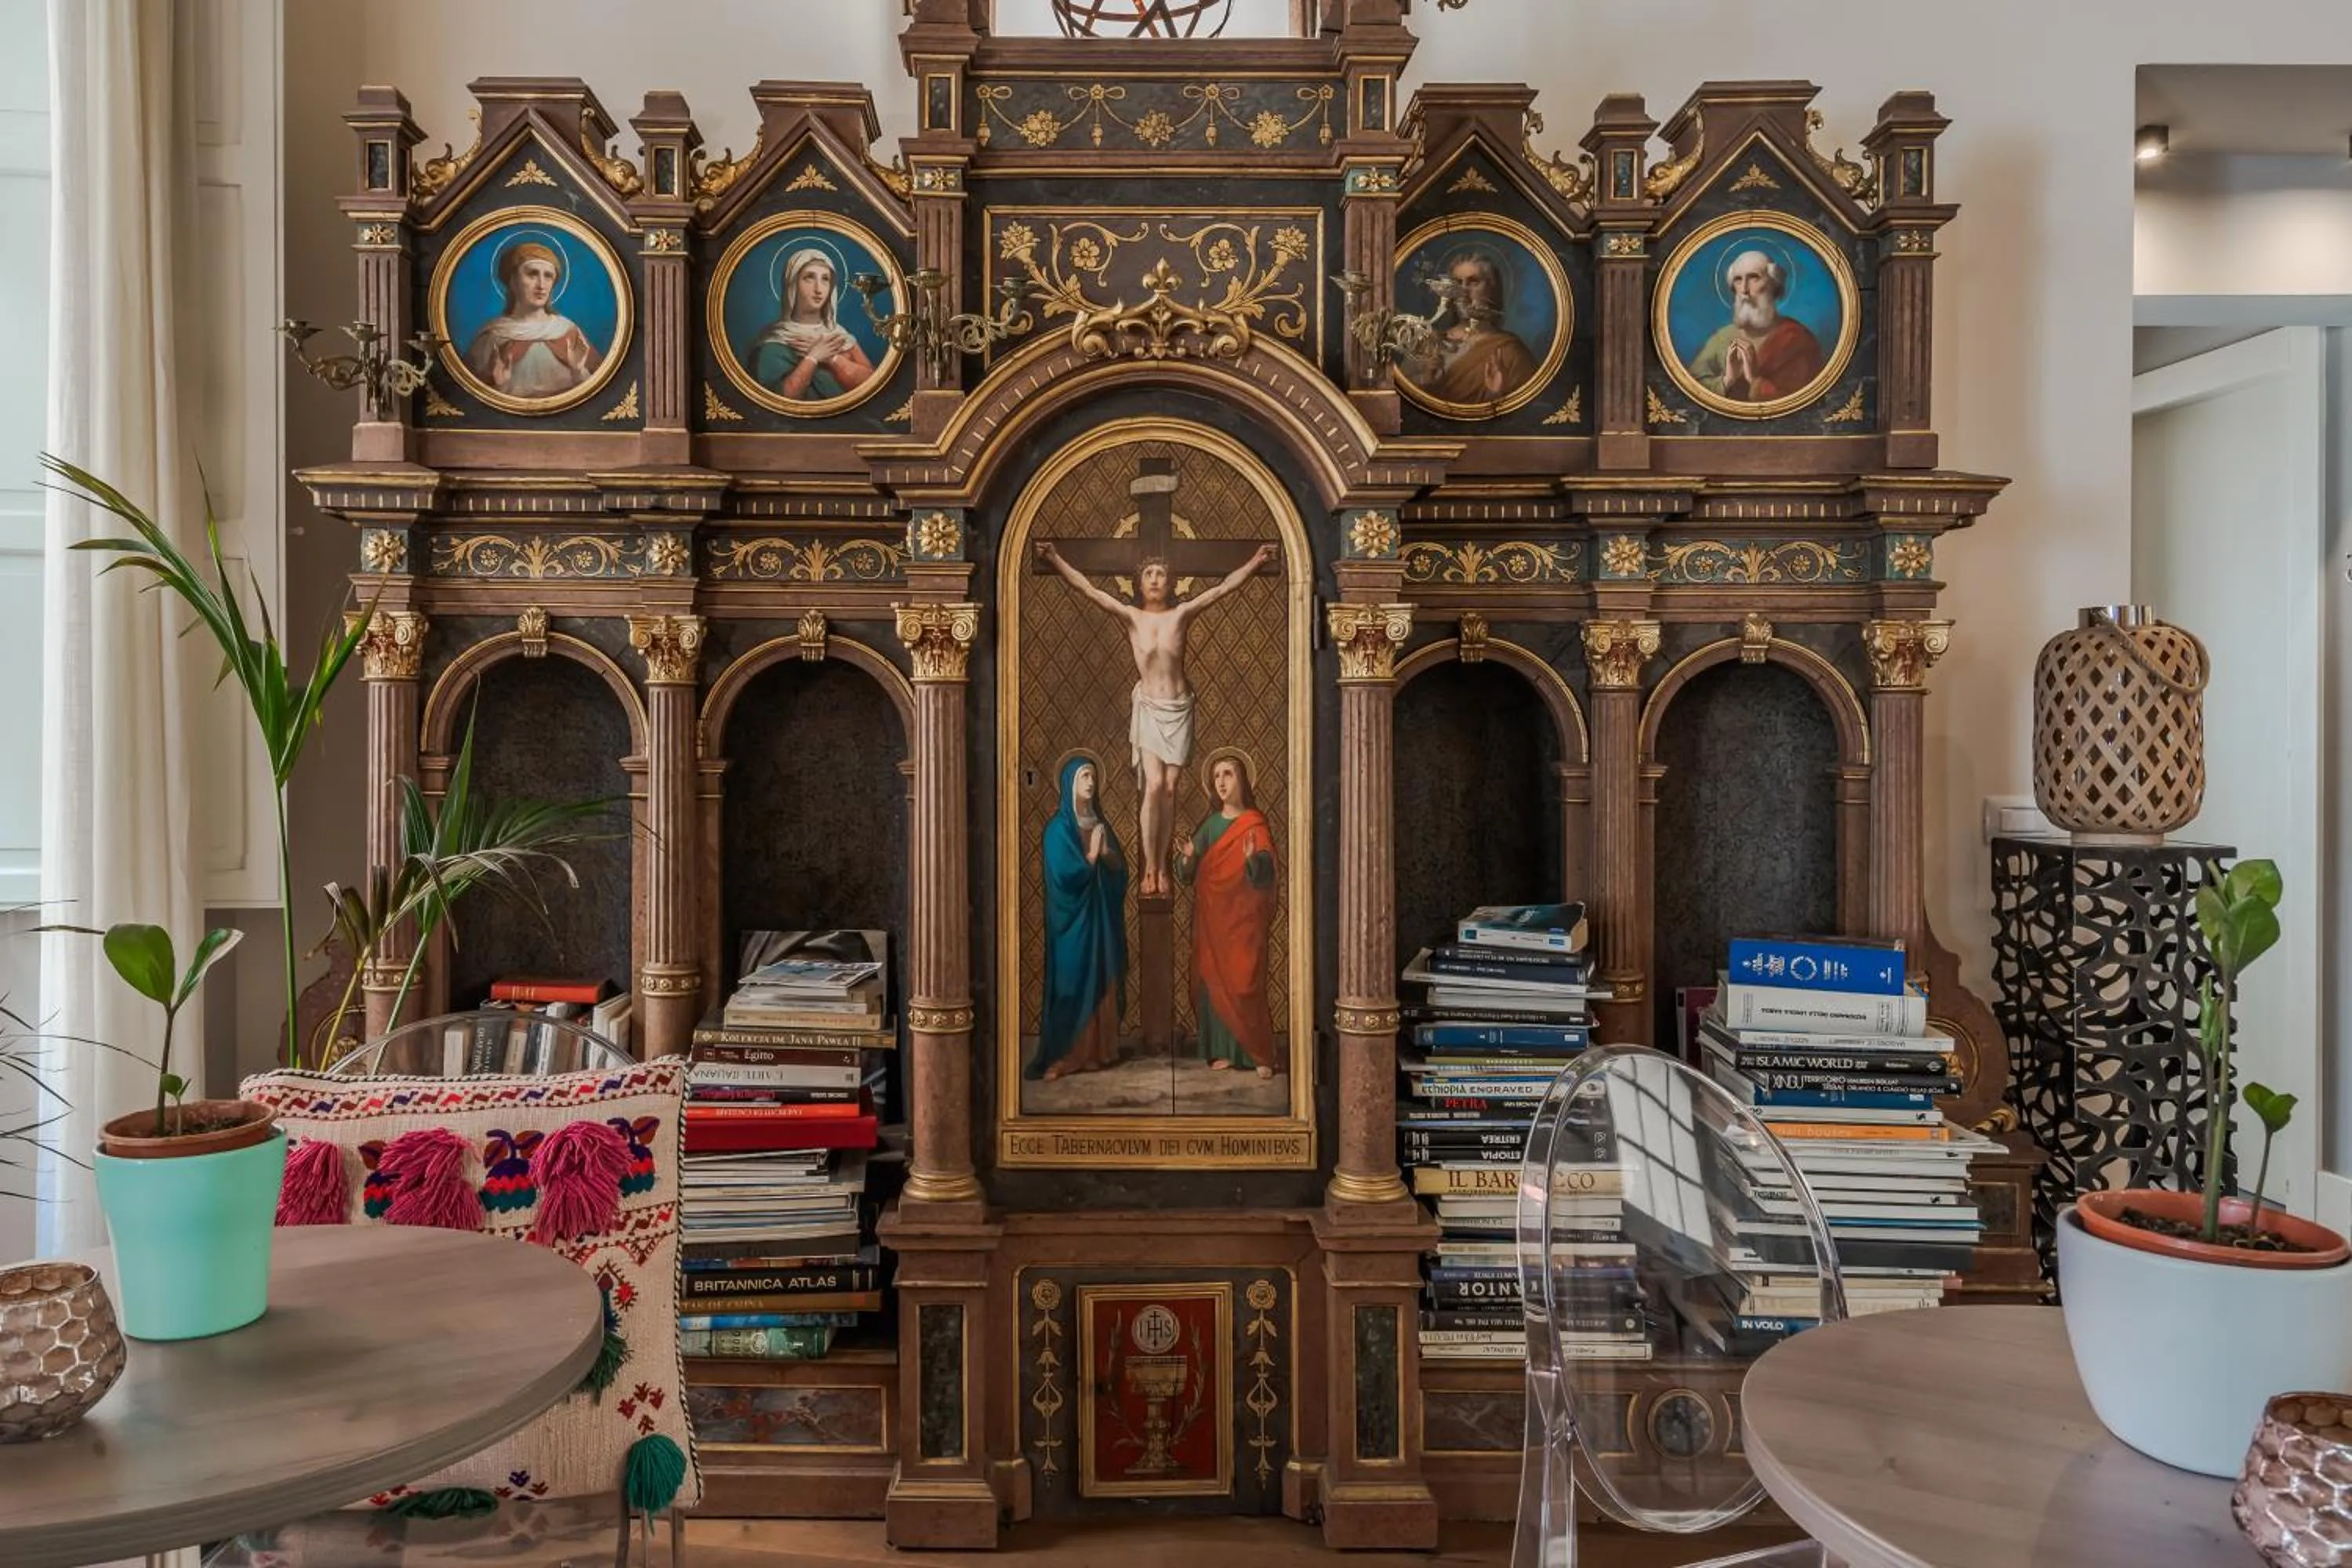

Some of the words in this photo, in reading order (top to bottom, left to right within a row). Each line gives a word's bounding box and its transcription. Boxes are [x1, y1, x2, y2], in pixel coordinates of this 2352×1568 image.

[1755, 1056, 1805, 1068] ISLAMIC
[1806, 1058, 1853, 1069] WORLD
[1470, 1085, 1533, 1094] ENGRAVED
[1480, 1134, 1521, 1144] ERITREA
[1480, 1150, 1521, 1160] ETIOPIA
[1448, 1170, 1468, 1188] IL
[694, 1279, 783, 1292] BRITANNICA
[787, 1276, 837, 1288] ATLAS
[1138, 1319, 1172, 1339] IHS
[1740, 1320, 1753, 1330] IN
[1754, 1320, 1784, 1330] VOLO
